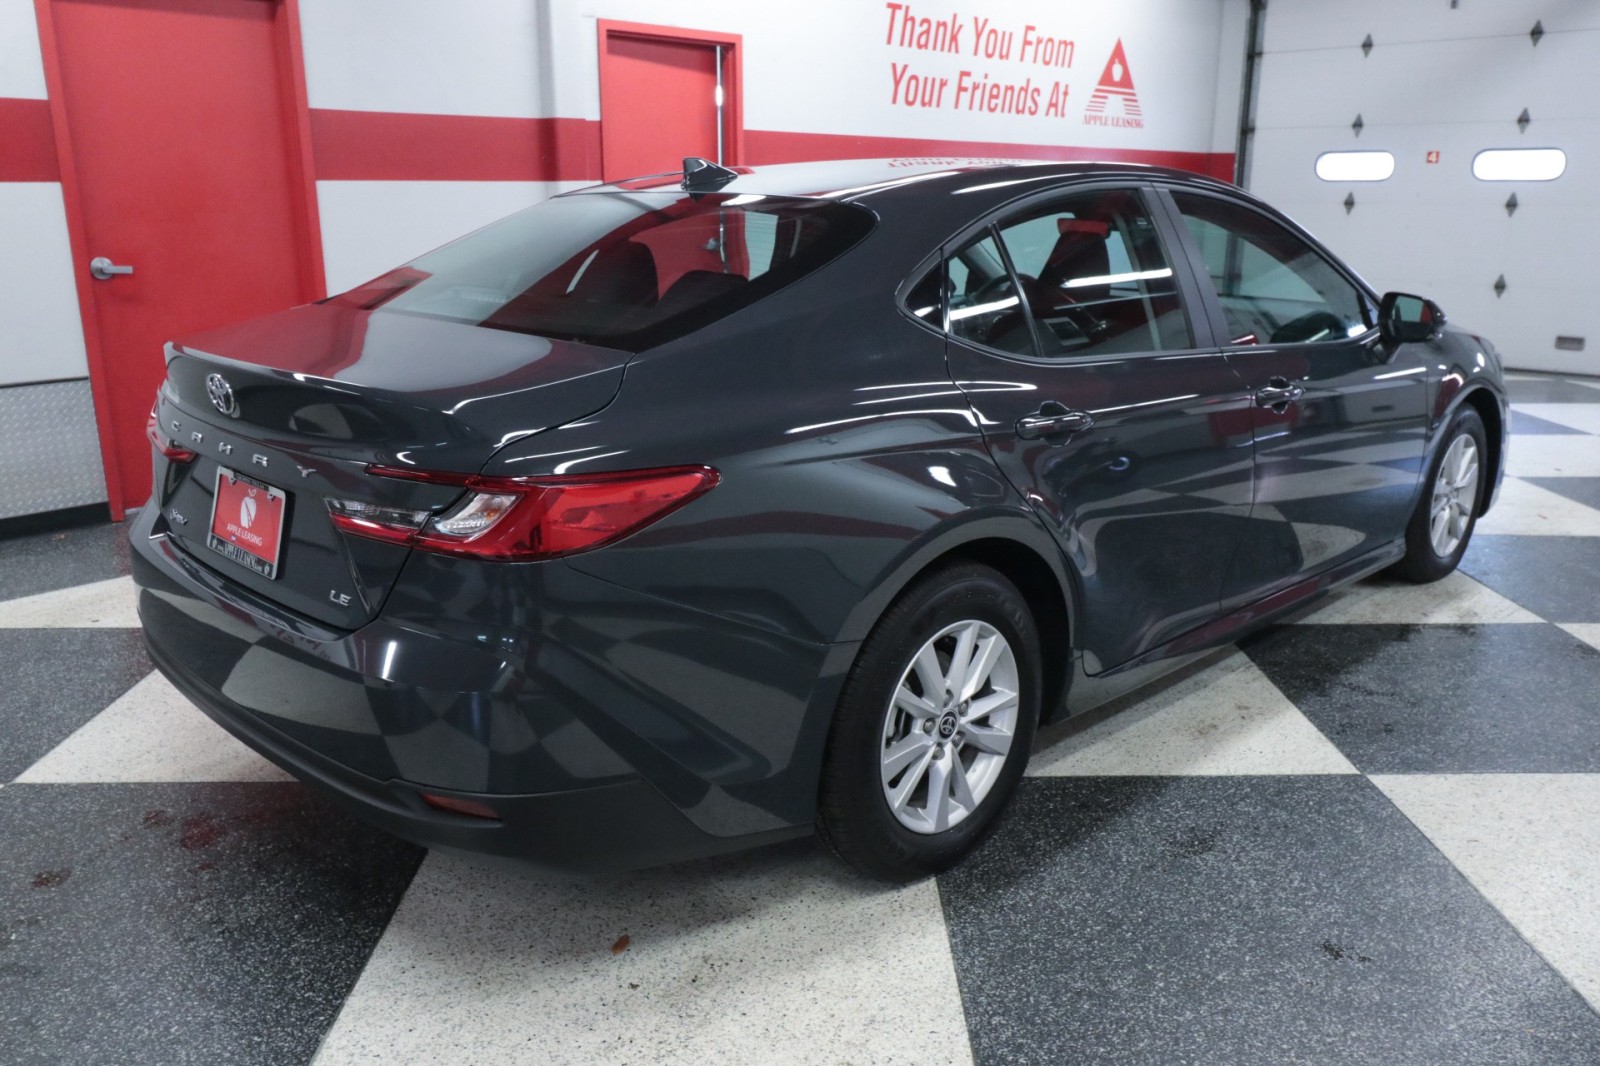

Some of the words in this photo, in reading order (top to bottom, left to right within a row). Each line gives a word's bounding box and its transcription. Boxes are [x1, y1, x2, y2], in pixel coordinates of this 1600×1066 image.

[886, 2, 964, 54] Thank
[973, 16, 1013, 61] You
[1020, 25, 1075, 69] From
[890, 63, 948, 109] Your
[954, 70, 1041, 117] Friends
[1045, 81, 1070, 118] At
[1082, 114, 1109, 127] APPLE
[1111, 115, 1144, 129] LEASING
[171, 420, 316, 478] CAMRY
[226, 523, 241, 536] APPLE
[241, 528, 263, 546] LEASING
[329, 590, 351, 606] LE
